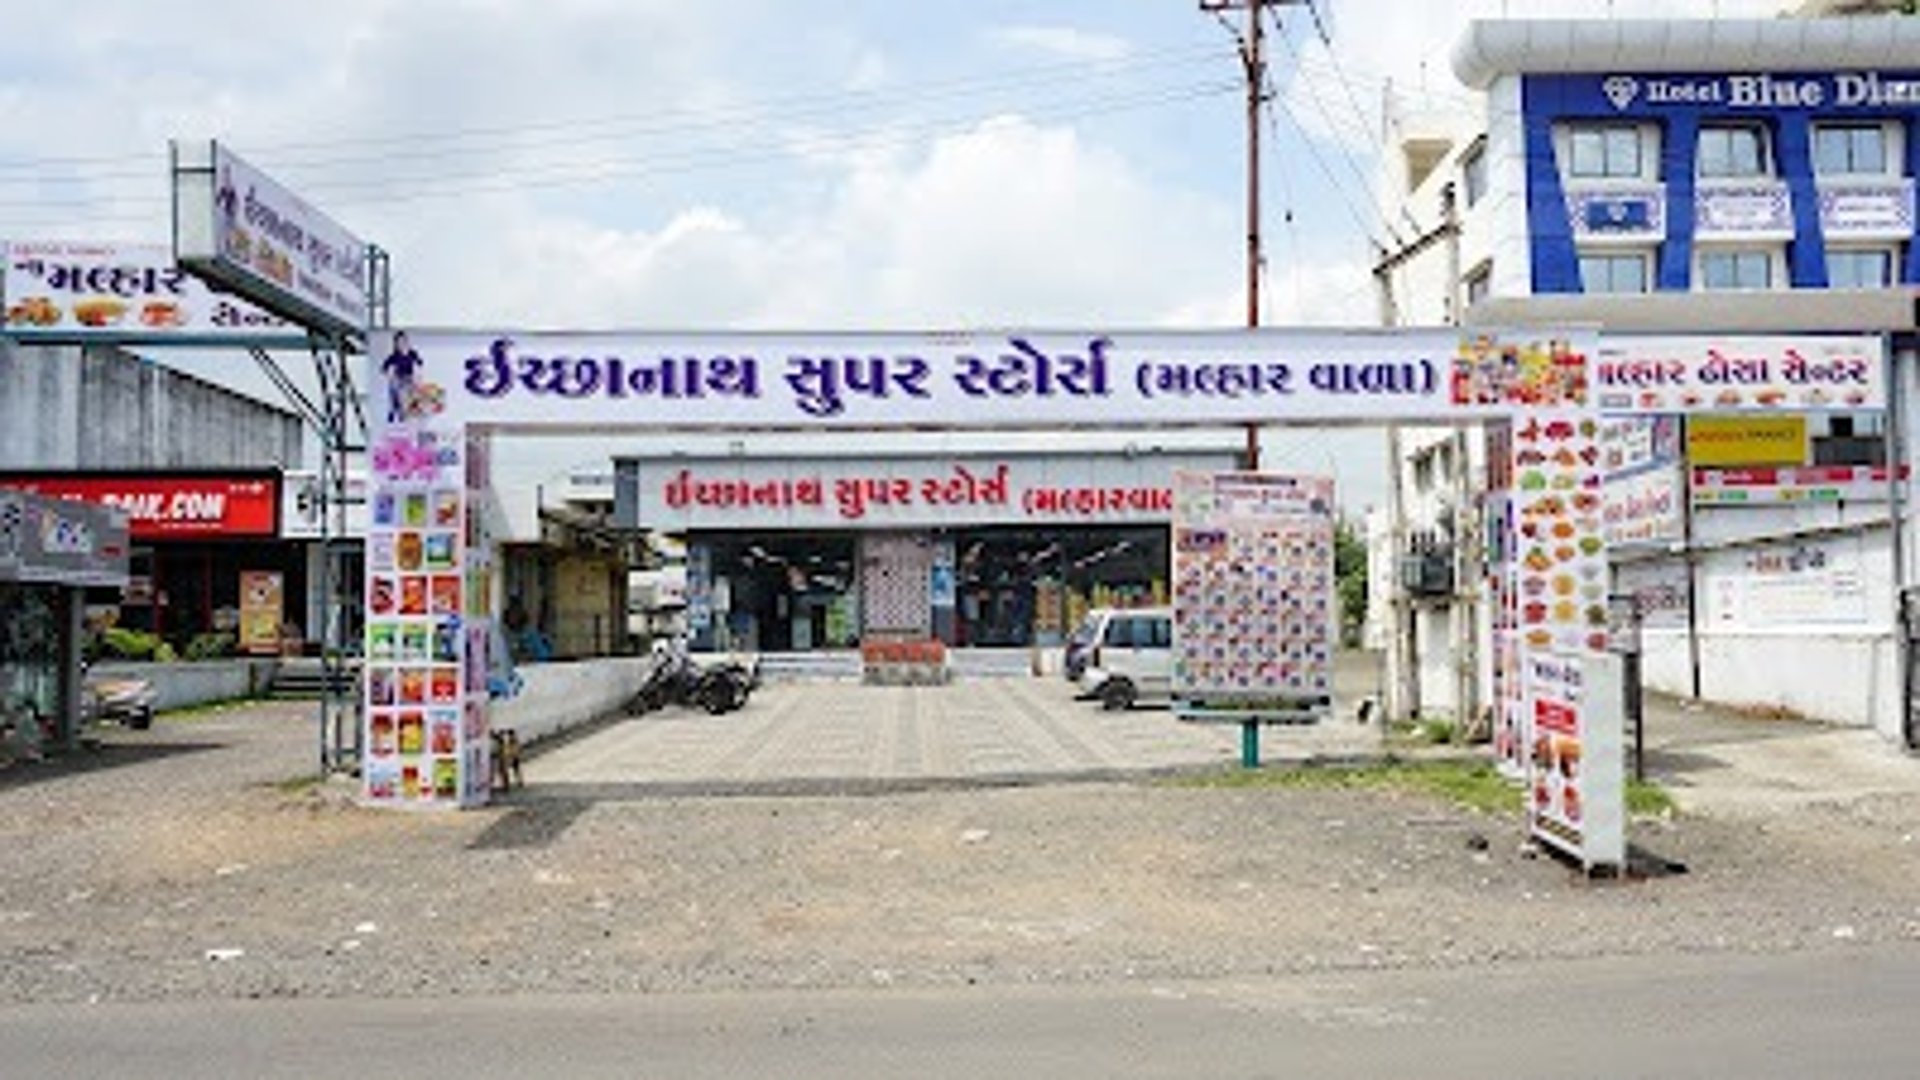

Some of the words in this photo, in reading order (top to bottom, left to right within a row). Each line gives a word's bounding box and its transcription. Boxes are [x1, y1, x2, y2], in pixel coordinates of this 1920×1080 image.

[1646, 81, 1720, 102] Hotel
[1728, 72, 1822, 106] Blue
[47, 263, 188, 298] મલ્હાર
[463, 339, 762, 399] ઈચ્છાનાથ
[782, 356, 934, 417] સુપર
[954, 336, 1112, 398] સ્ટોર્સ
[1135, 361, 1296, 399] (મલ્હાર
[1307, 357, 1439, 395] વાળા)
[1697, 349, 1771, 386] ઢોસા
[664, 469, 824, 510] ઈચ્છાનાથ
[834, 477, 912, 518] સુપર
[920, 465, 1010, 506] સ્ટોર્સ
